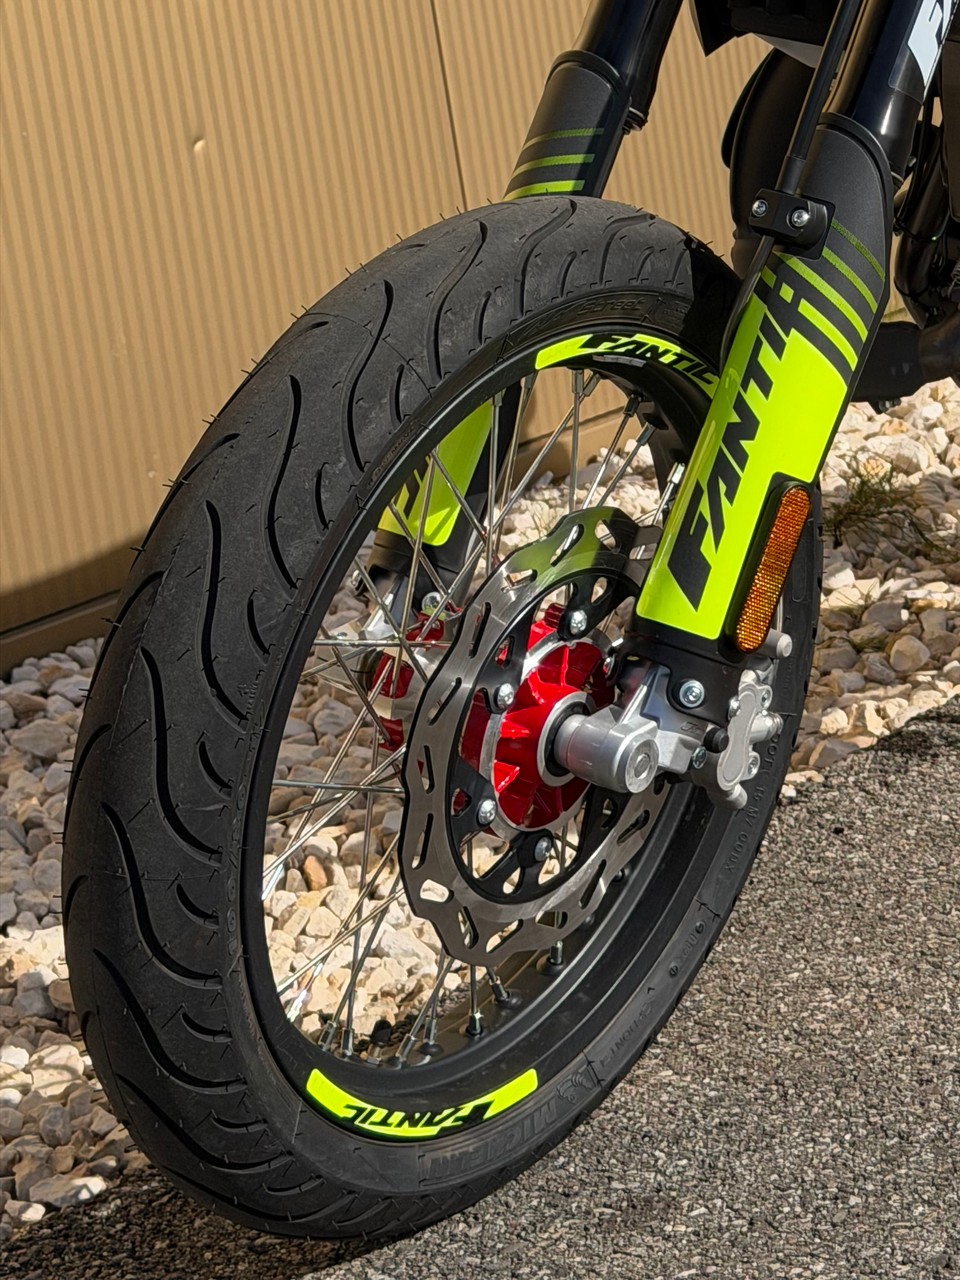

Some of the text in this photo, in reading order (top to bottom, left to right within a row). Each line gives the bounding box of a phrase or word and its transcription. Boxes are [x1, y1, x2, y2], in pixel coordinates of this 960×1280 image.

[577, 333, 721, 386] FANTIC
[668, 265, 797, 612] FANTIC
[342, 1099, 496, 1129] FANTIC
